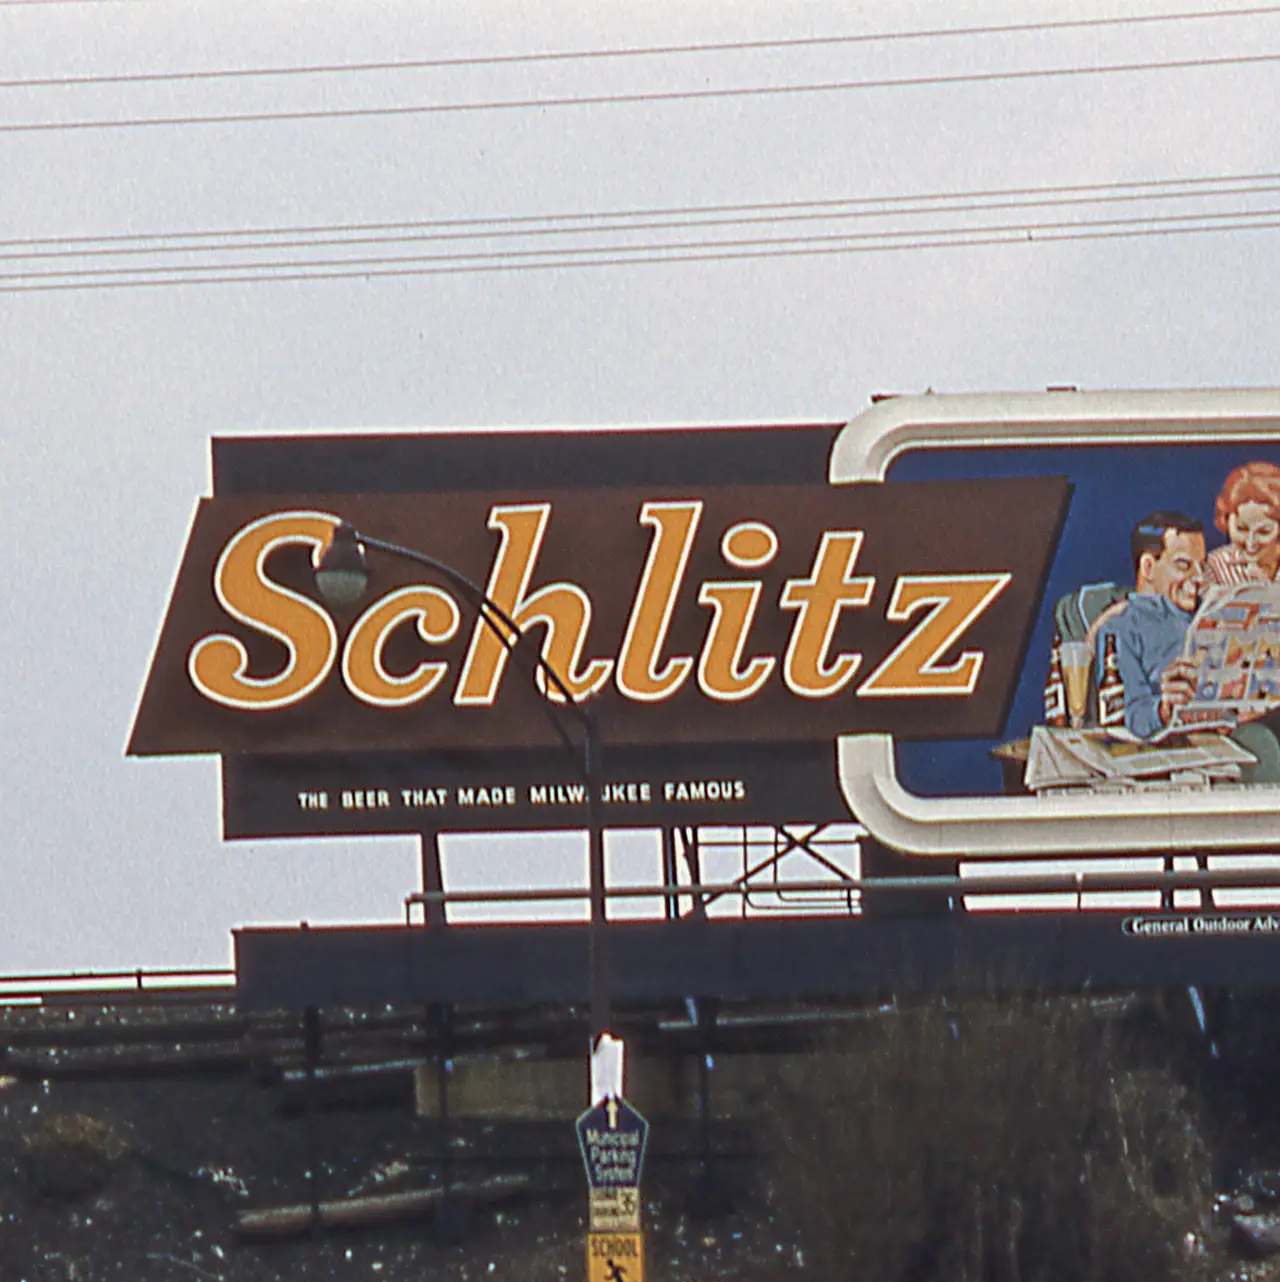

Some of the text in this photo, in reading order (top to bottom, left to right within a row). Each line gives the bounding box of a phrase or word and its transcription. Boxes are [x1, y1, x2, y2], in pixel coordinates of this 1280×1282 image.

[188, 500, 1012, 709] Schlitz
[297, 780, 746, 809] THE BEER THAT MADE MILWUKEE FAMOUS
[1131, 915, 1189, 935] General
[1192, 914, 1250, 933] Outdoor
[591, 1236, 639, 1257] SCHOOL
